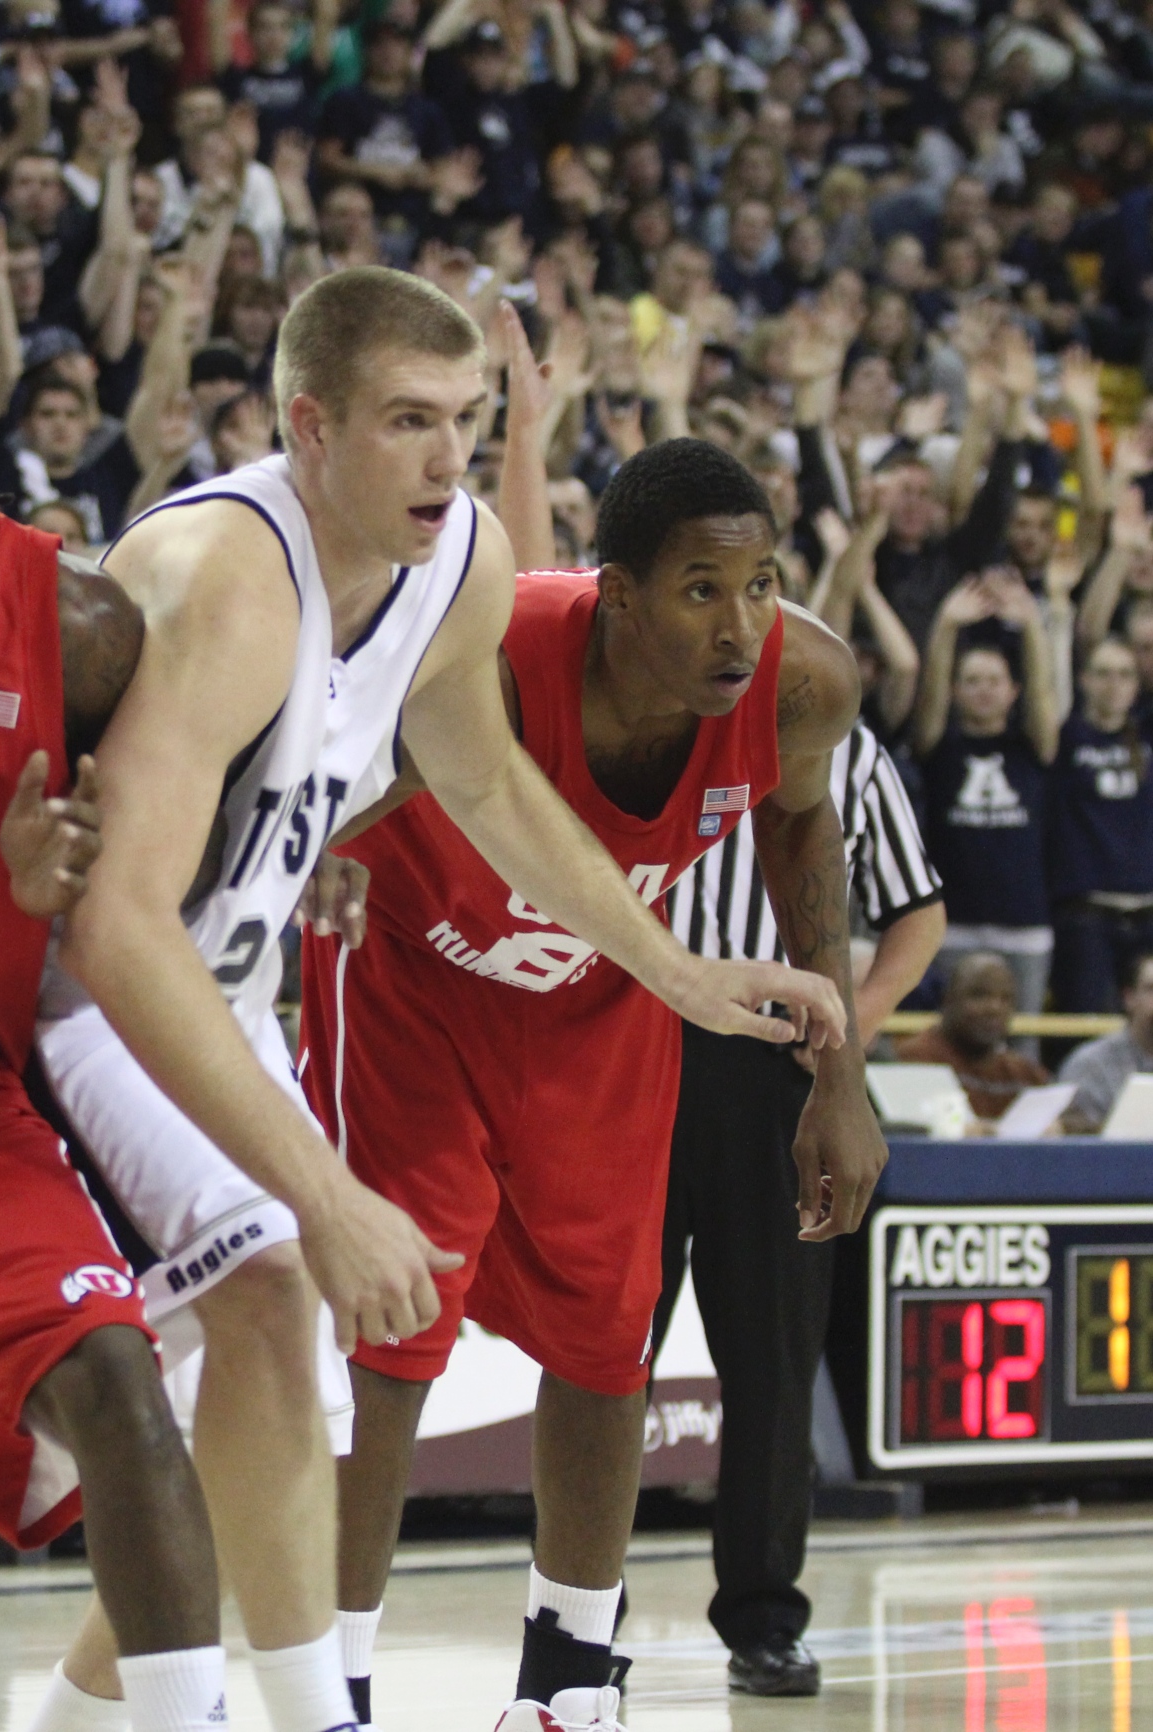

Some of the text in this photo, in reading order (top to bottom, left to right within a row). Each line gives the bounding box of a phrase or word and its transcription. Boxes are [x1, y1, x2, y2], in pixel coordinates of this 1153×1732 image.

[165, 1223, 263, 1294] Aggies
[891, 1225, 1051, 1288] AGGIES
[961, 1301, 1045, 1439] 12
